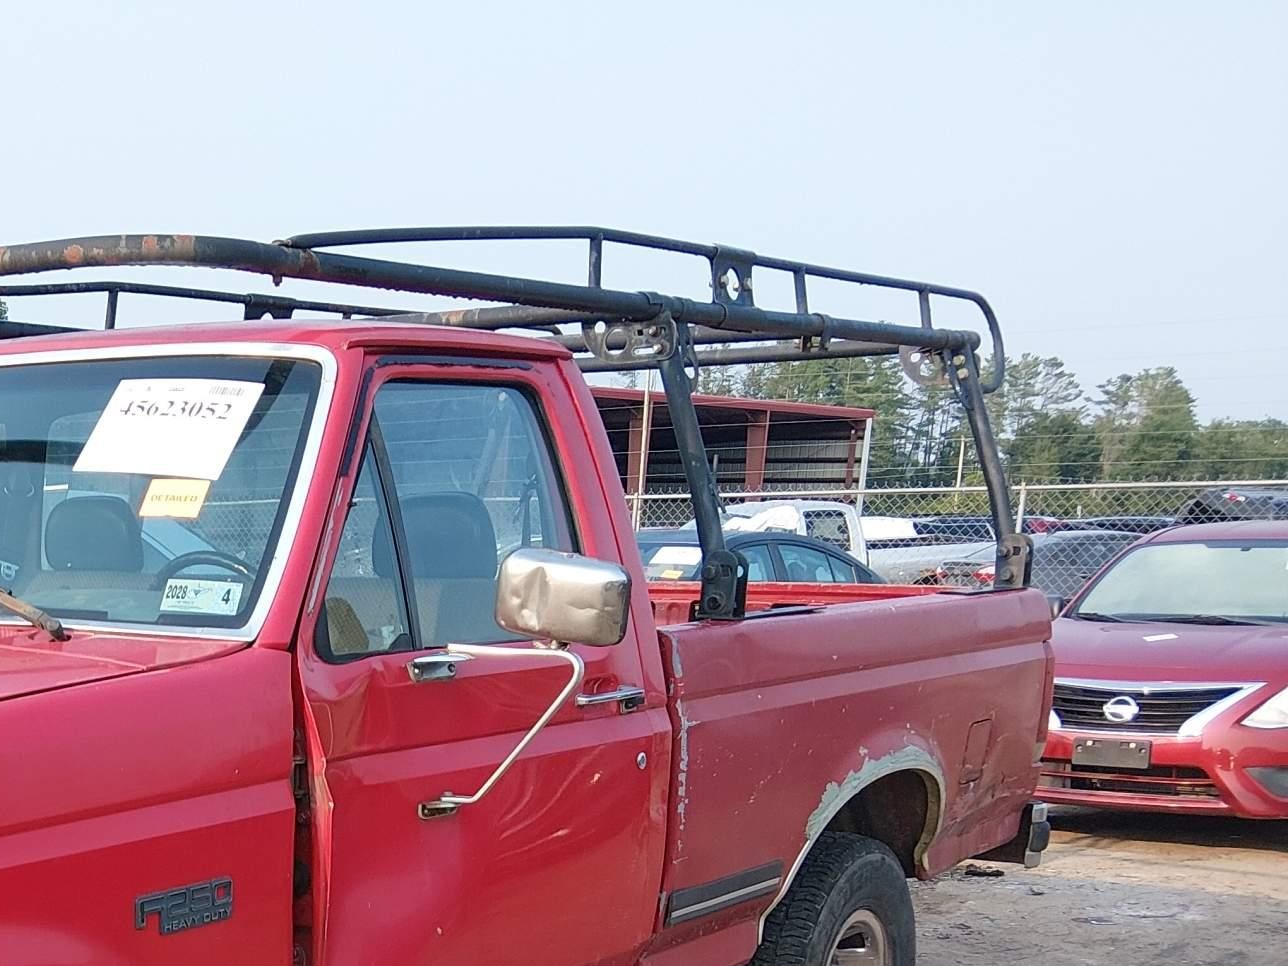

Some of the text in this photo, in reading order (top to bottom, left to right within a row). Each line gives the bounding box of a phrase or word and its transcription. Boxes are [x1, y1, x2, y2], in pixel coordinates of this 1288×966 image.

[120, 400, 232, 420] 45623052
[166, 584, 188, 600] 2028
[221, 588, 232, 605] 4
[164, 907, 232, 932] HEAVY DUTY
